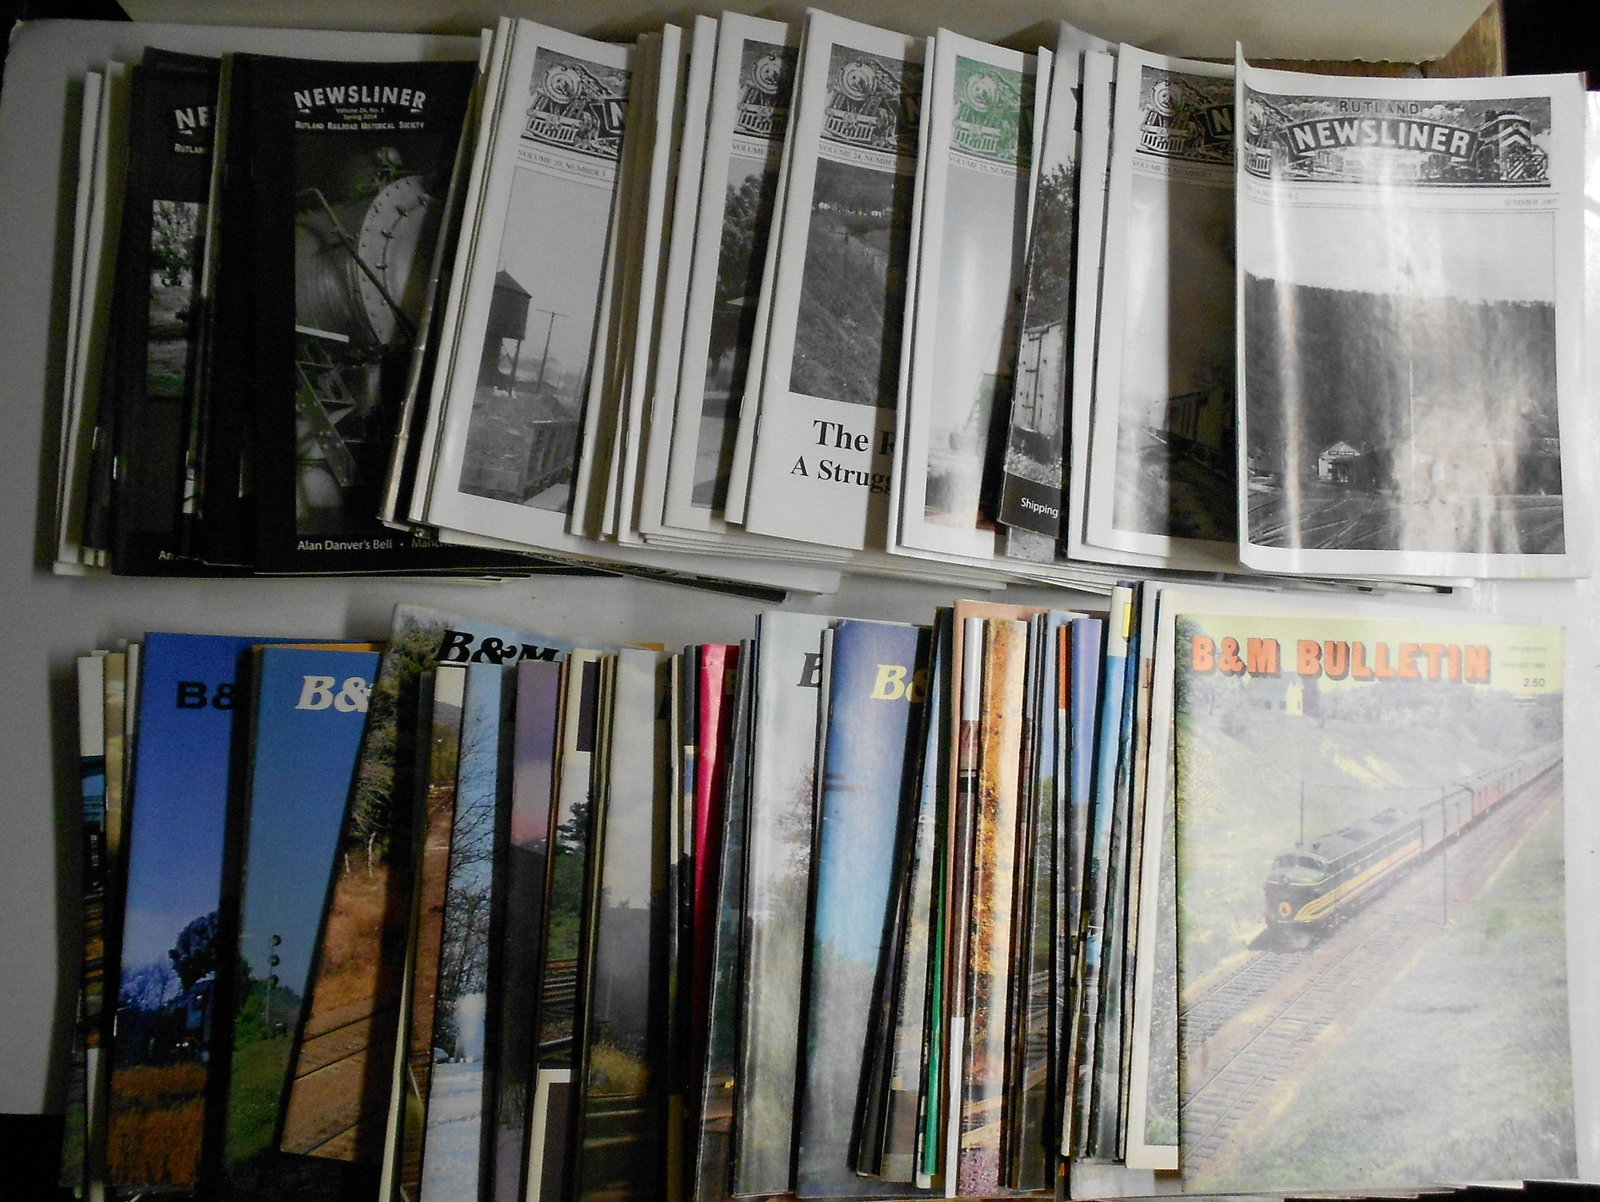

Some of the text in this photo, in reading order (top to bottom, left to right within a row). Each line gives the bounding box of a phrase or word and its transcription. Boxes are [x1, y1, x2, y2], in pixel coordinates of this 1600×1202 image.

[294, 85, 426, 110] NEWSLINER
[1338, 99, 1420, 115] RUTLAND
[399, 120, 425, 129] SOCIETY
[1293, 119, 1471, 157] NEWSLINER
[518, 149, 551, 165] VOLUME
[819, 143, 851, 159] VOLUME
[813, 419, 869, 452] The
[791, 455, 809, 477] A
[1020, 497, 1059, 519] Shipping
[297, 539, 322, 551] Alan
[324, 539, 370, 551] Danver's
[373, 539, 392, 551] Bell
[1191, 634, 1491, 684] B&M BULLETIN
